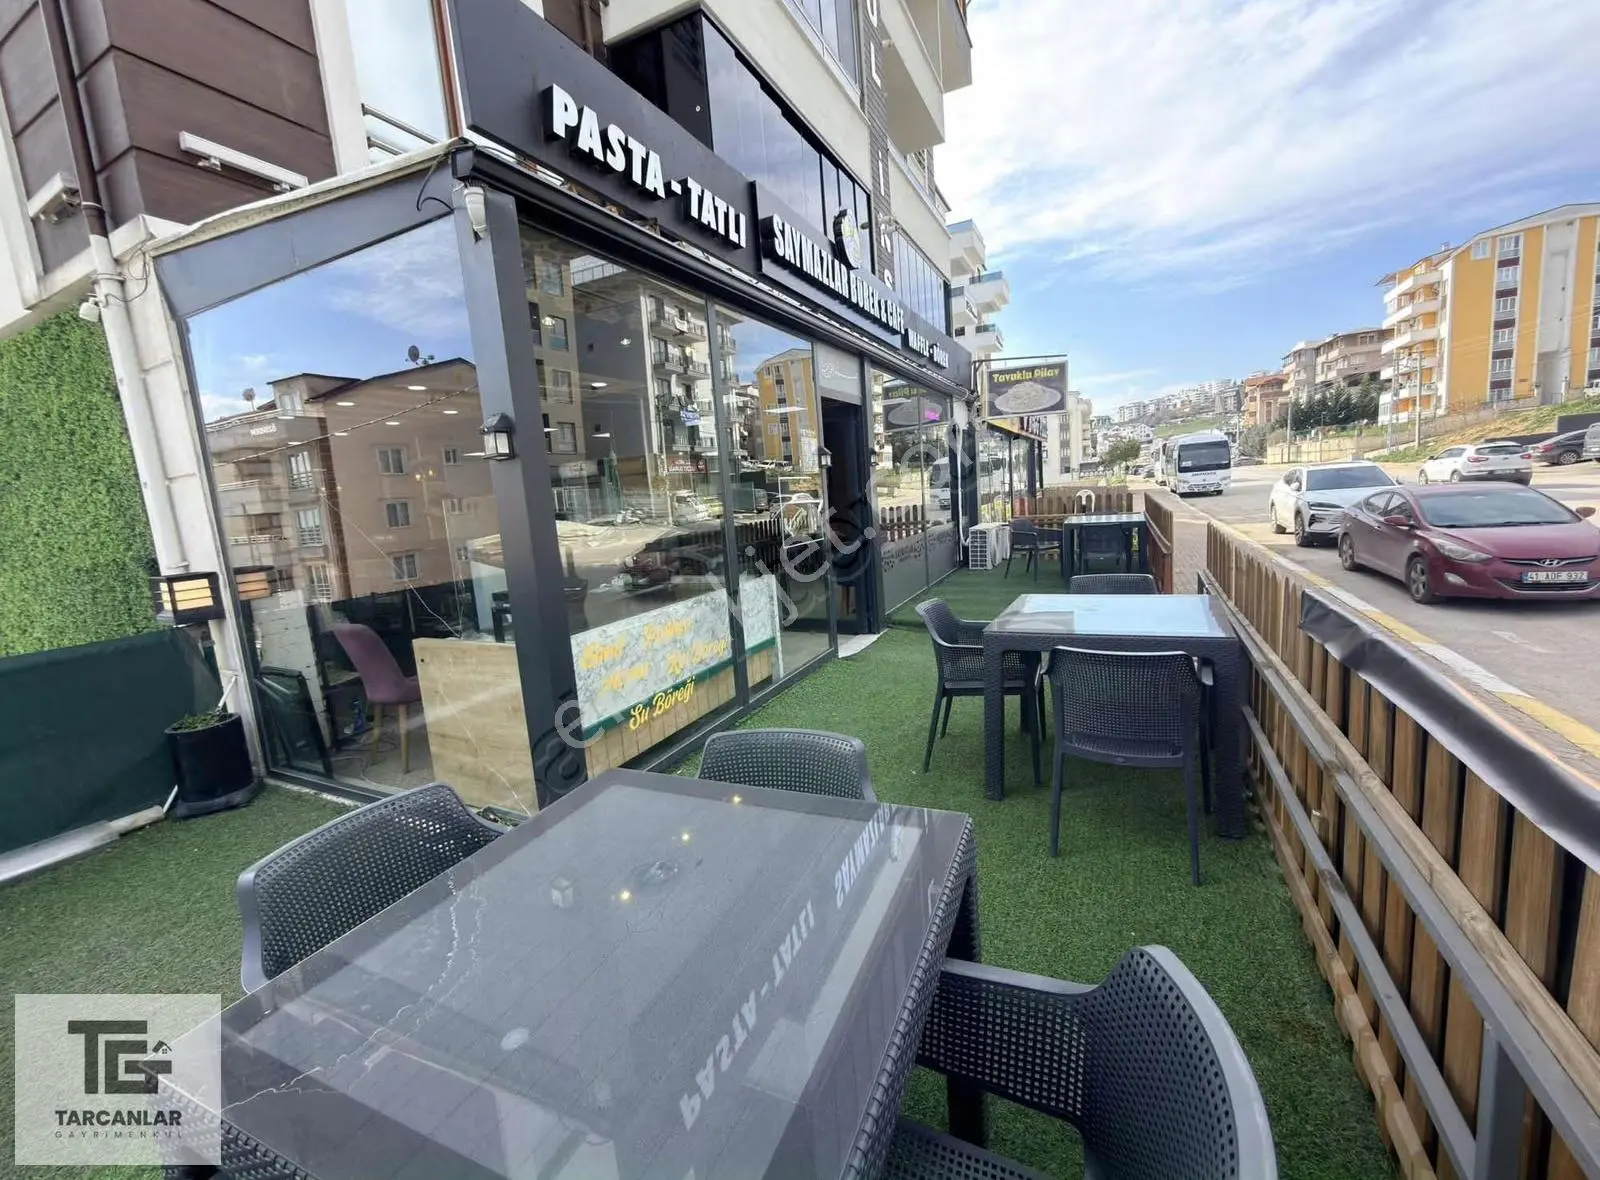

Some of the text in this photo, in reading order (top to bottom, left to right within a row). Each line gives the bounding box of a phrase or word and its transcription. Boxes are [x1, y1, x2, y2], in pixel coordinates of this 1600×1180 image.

[552, 83, 666, 199] PASTA
[687, 176, 747, 249] TATLI
[772, 213, 850, 299] SAYMAZLAR
[992, 367, 1060, 384] Tavuklu Pilav
[628, 703, 651, 730] Su
[652, 676, 697, 717] Böreği
